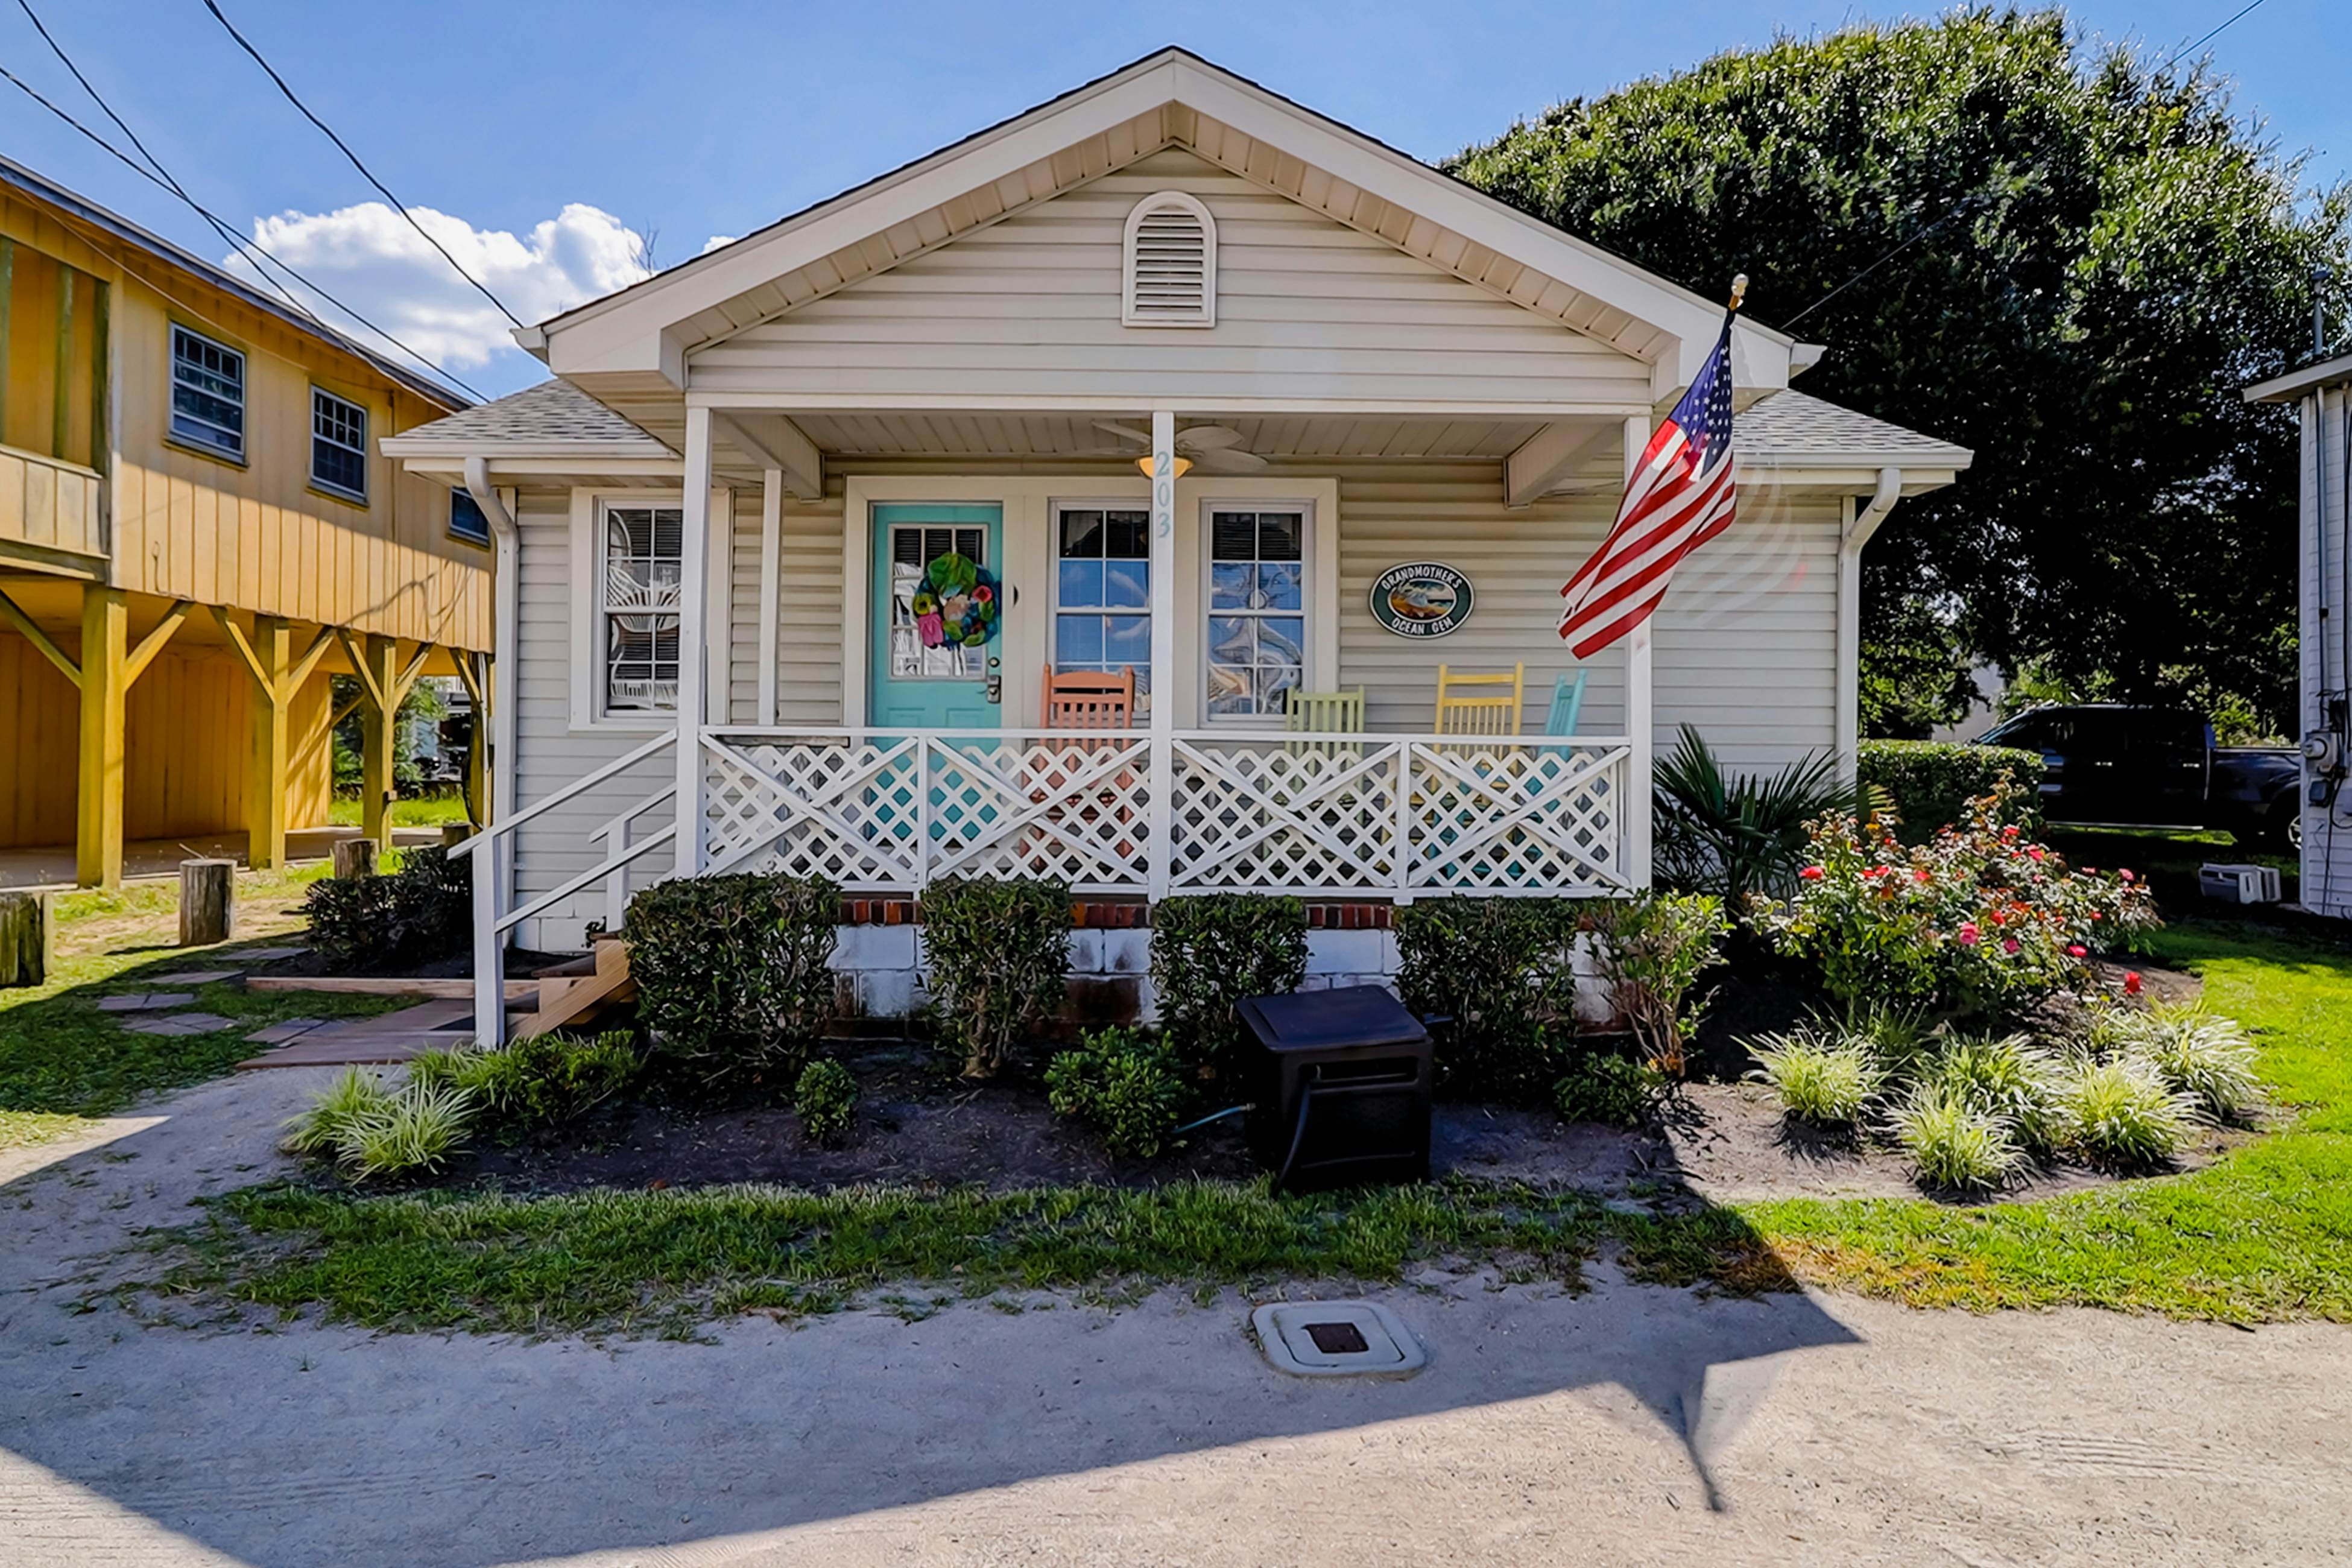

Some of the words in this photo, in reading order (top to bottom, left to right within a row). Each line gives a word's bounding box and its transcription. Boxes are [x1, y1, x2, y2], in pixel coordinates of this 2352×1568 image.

[1155, 450, 1171, 538] 203
[1391, 617, 1425, 634] OCEAN
[1431, 616, 1454, 633] GEM
